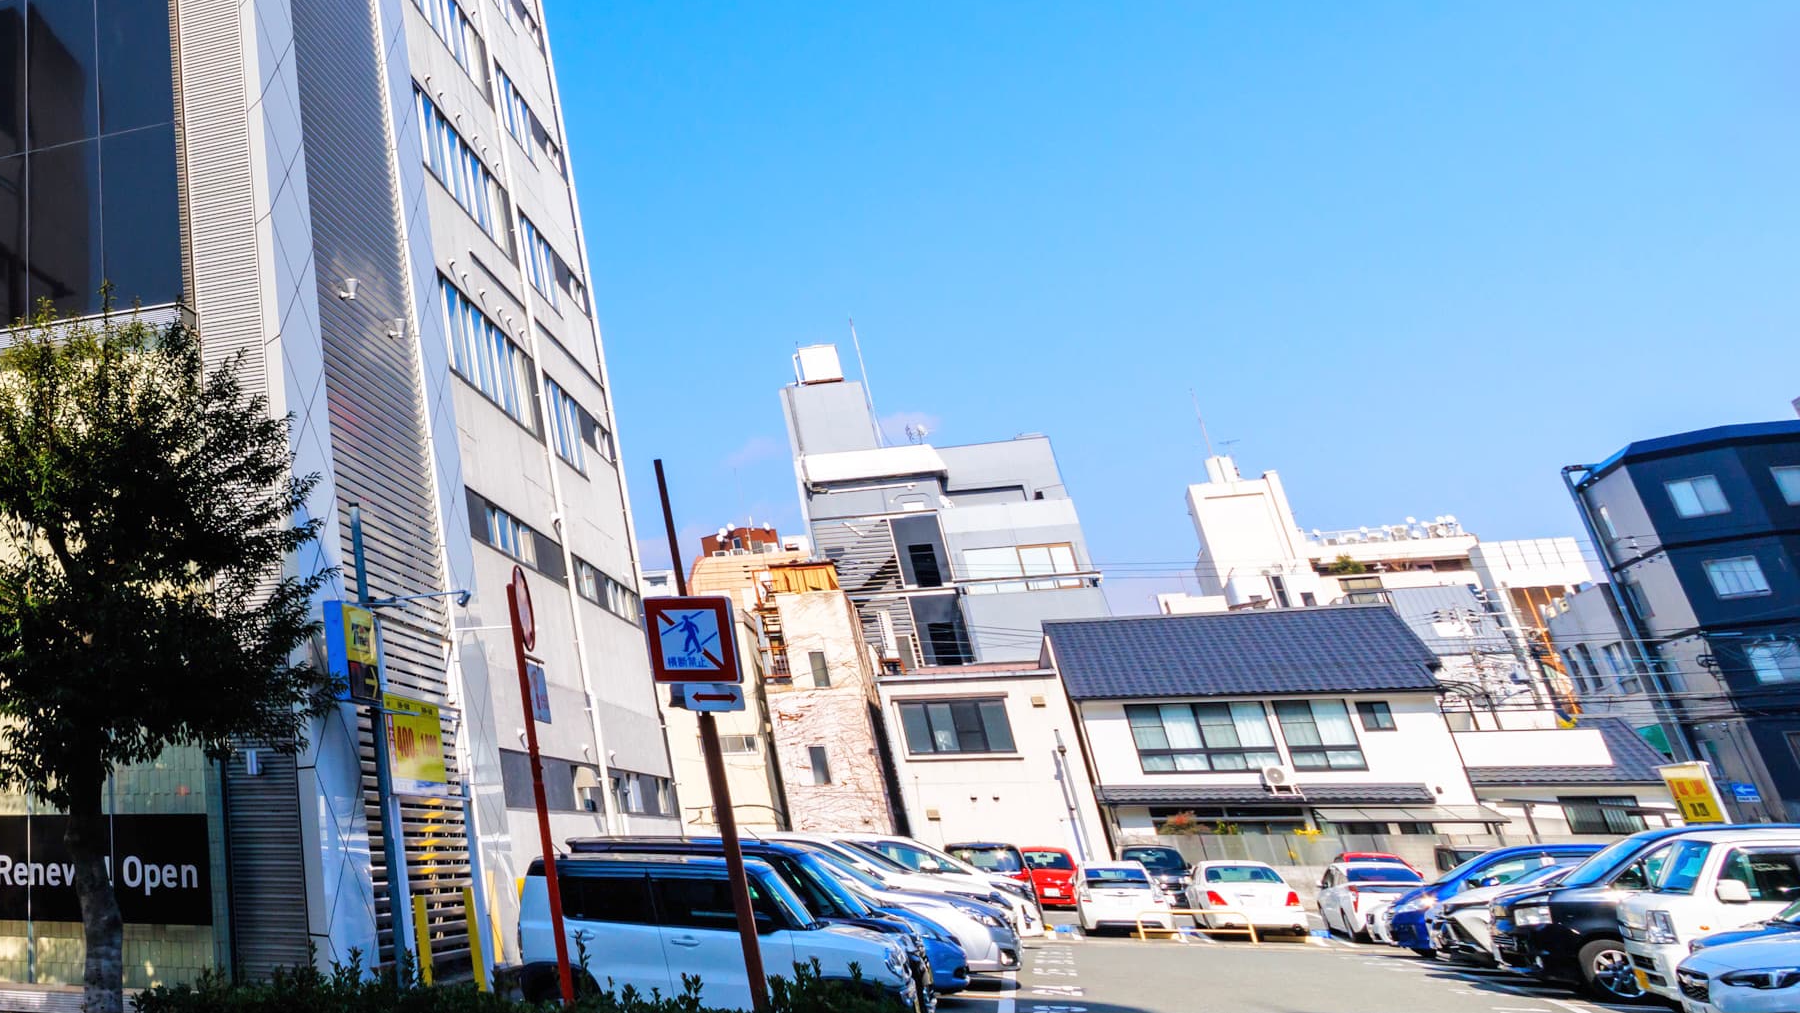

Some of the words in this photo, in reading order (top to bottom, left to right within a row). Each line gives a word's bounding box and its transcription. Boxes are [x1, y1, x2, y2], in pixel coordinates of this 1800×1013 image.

[667, 657, 708, 668] 横断禁止
[122, 855, 199, 896] Open
